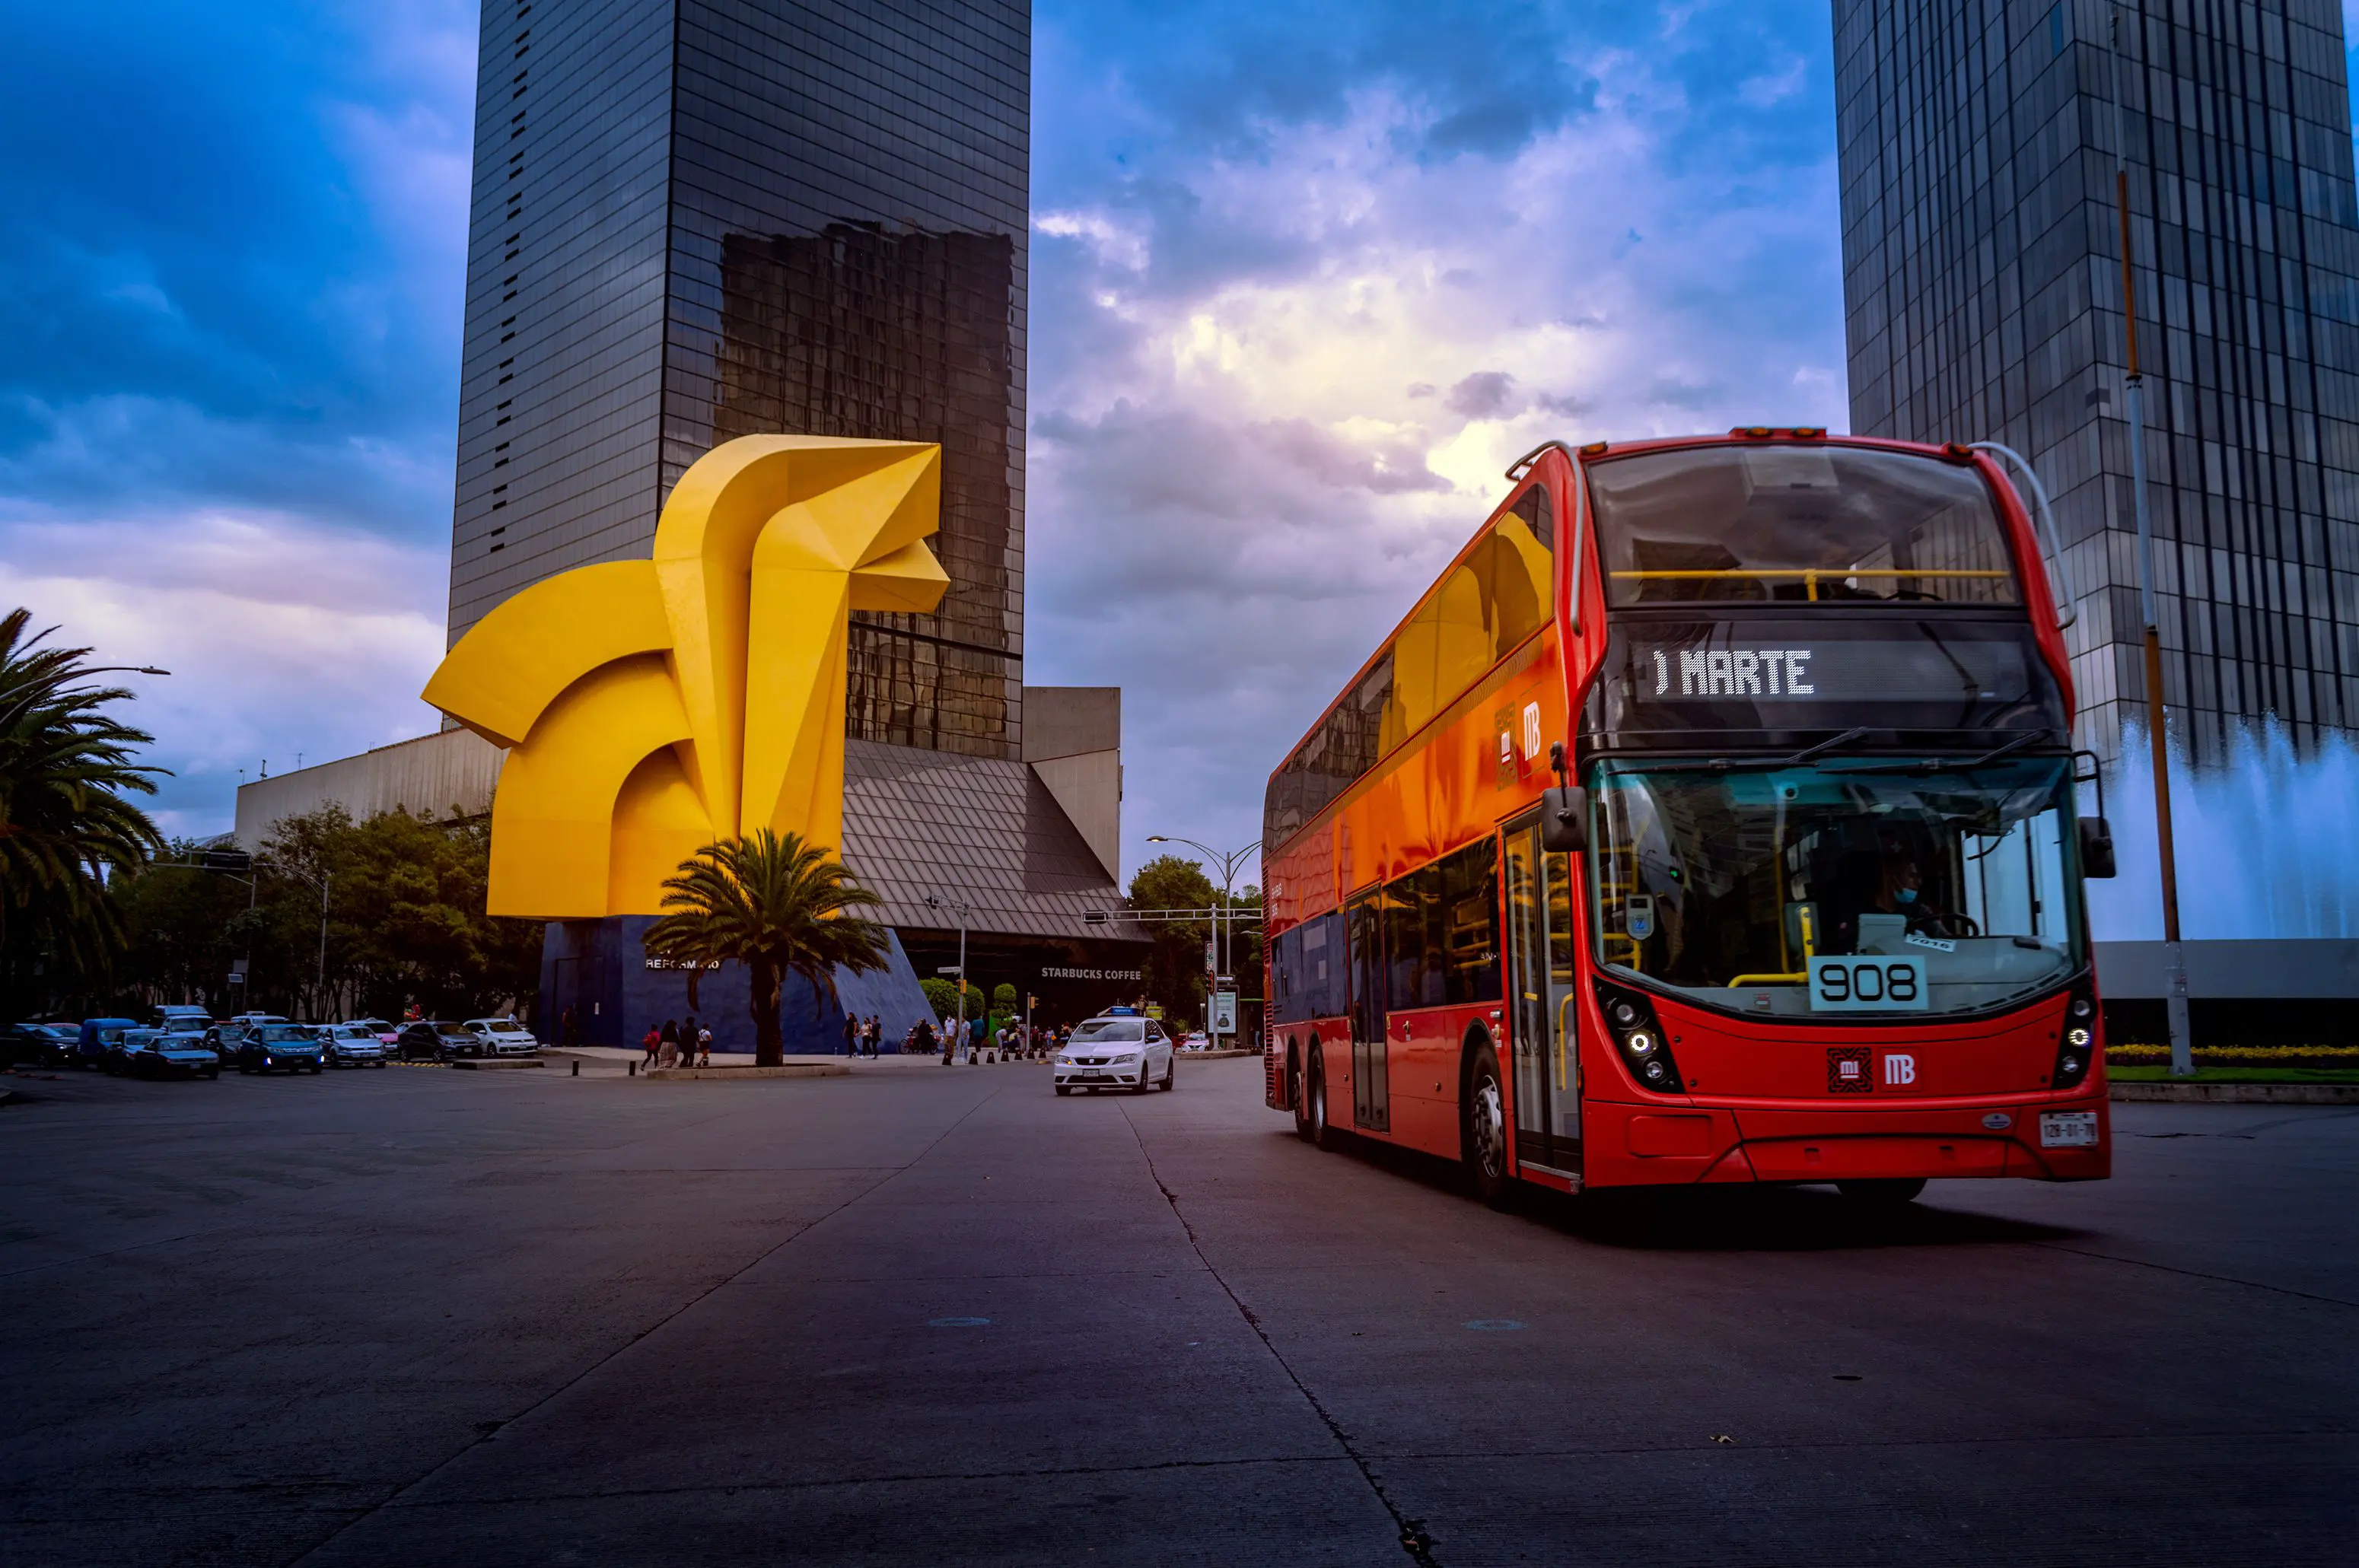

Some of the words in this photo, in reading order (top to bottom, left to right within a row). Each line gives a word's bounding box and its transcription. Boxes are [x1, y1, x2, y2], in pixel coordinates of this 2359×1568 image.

[1679, 650, 1814, 695] MARTE
[1523, 700, 1541, 762] MB
[1041, 967, 1103, 979] STARBUCKS
[1104, 970, 1141, 981] COFFEE
[1819, 963, 1917, 1002] 908
[1884, 1054, 1916, 1085] MB
